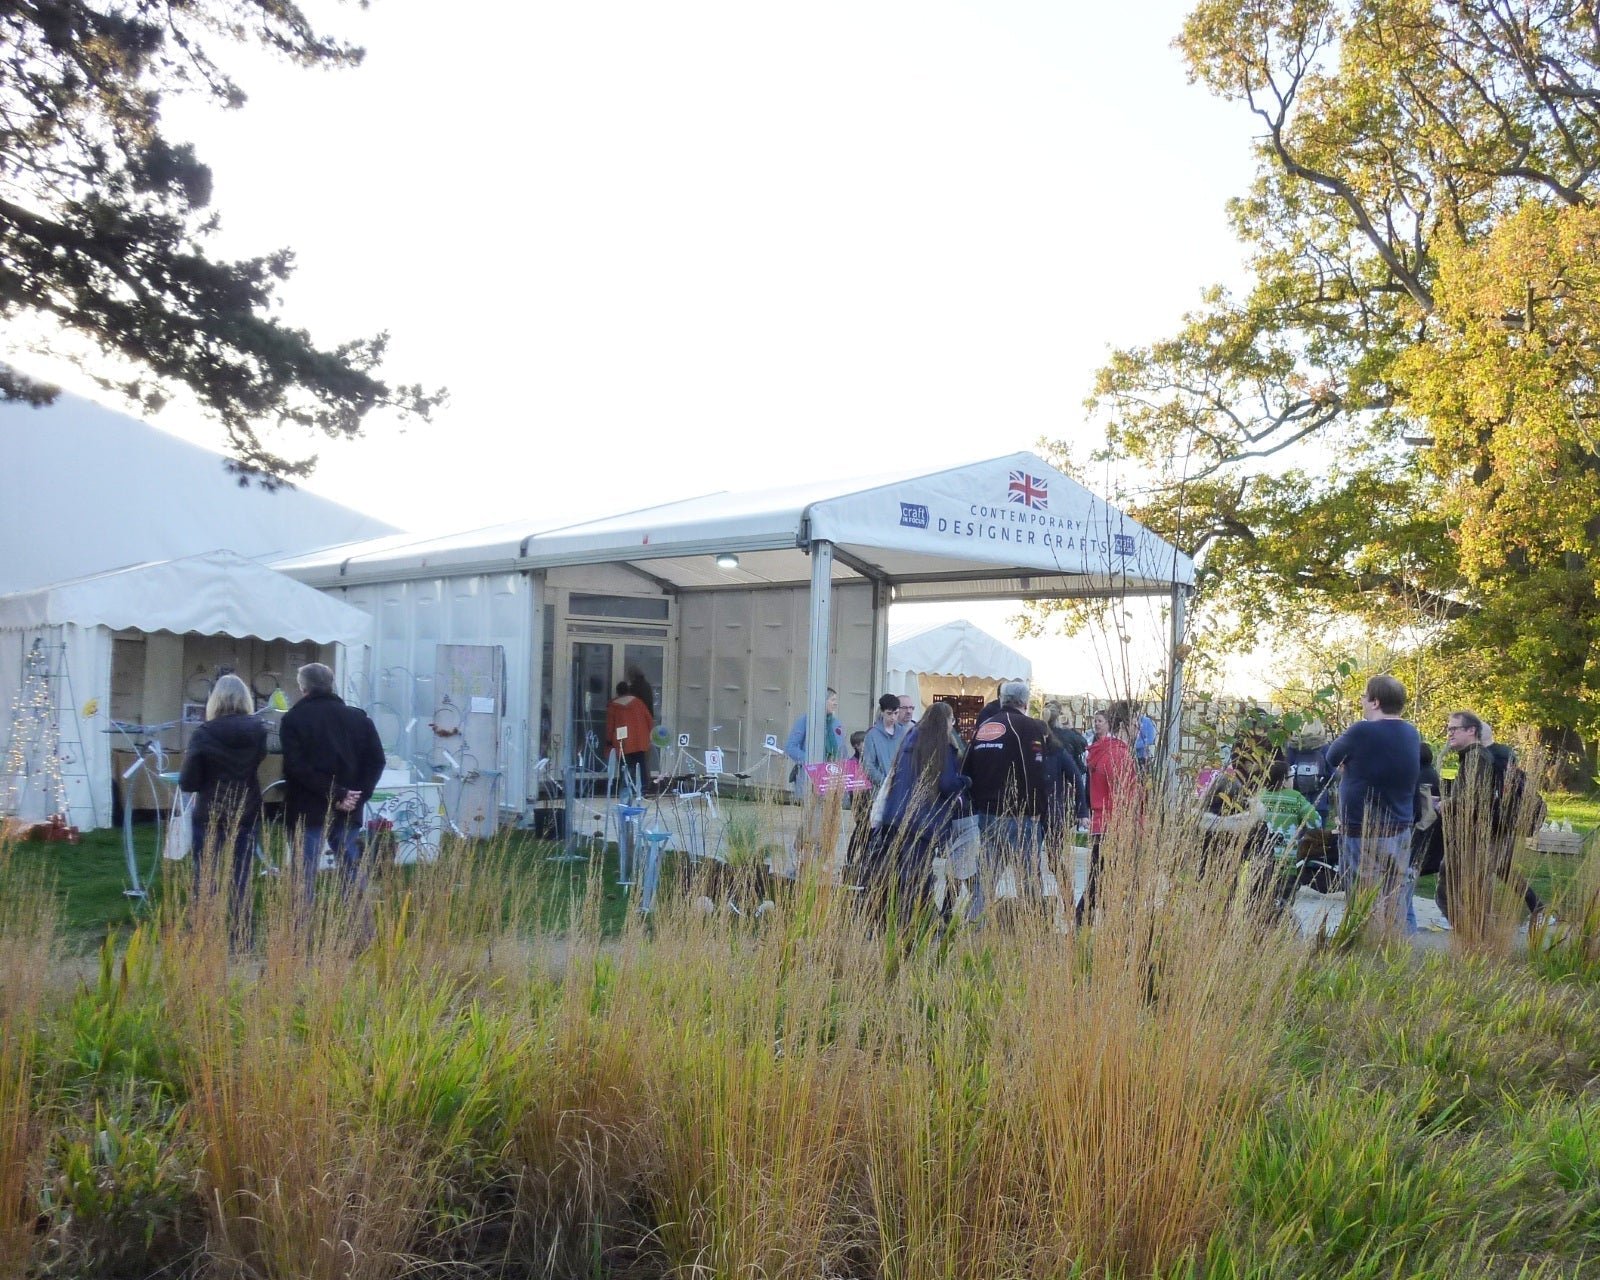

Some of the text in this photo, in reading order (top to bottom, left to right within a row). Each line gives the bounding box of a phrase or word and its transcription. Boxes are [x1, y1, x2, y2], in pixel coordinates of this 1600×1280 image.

[902, 507, 925, 520] craft
[970, 504, 1081, 531] CONTEMPORARY
[938, 518, 1107, 554] DESIGNER CRAFTS
